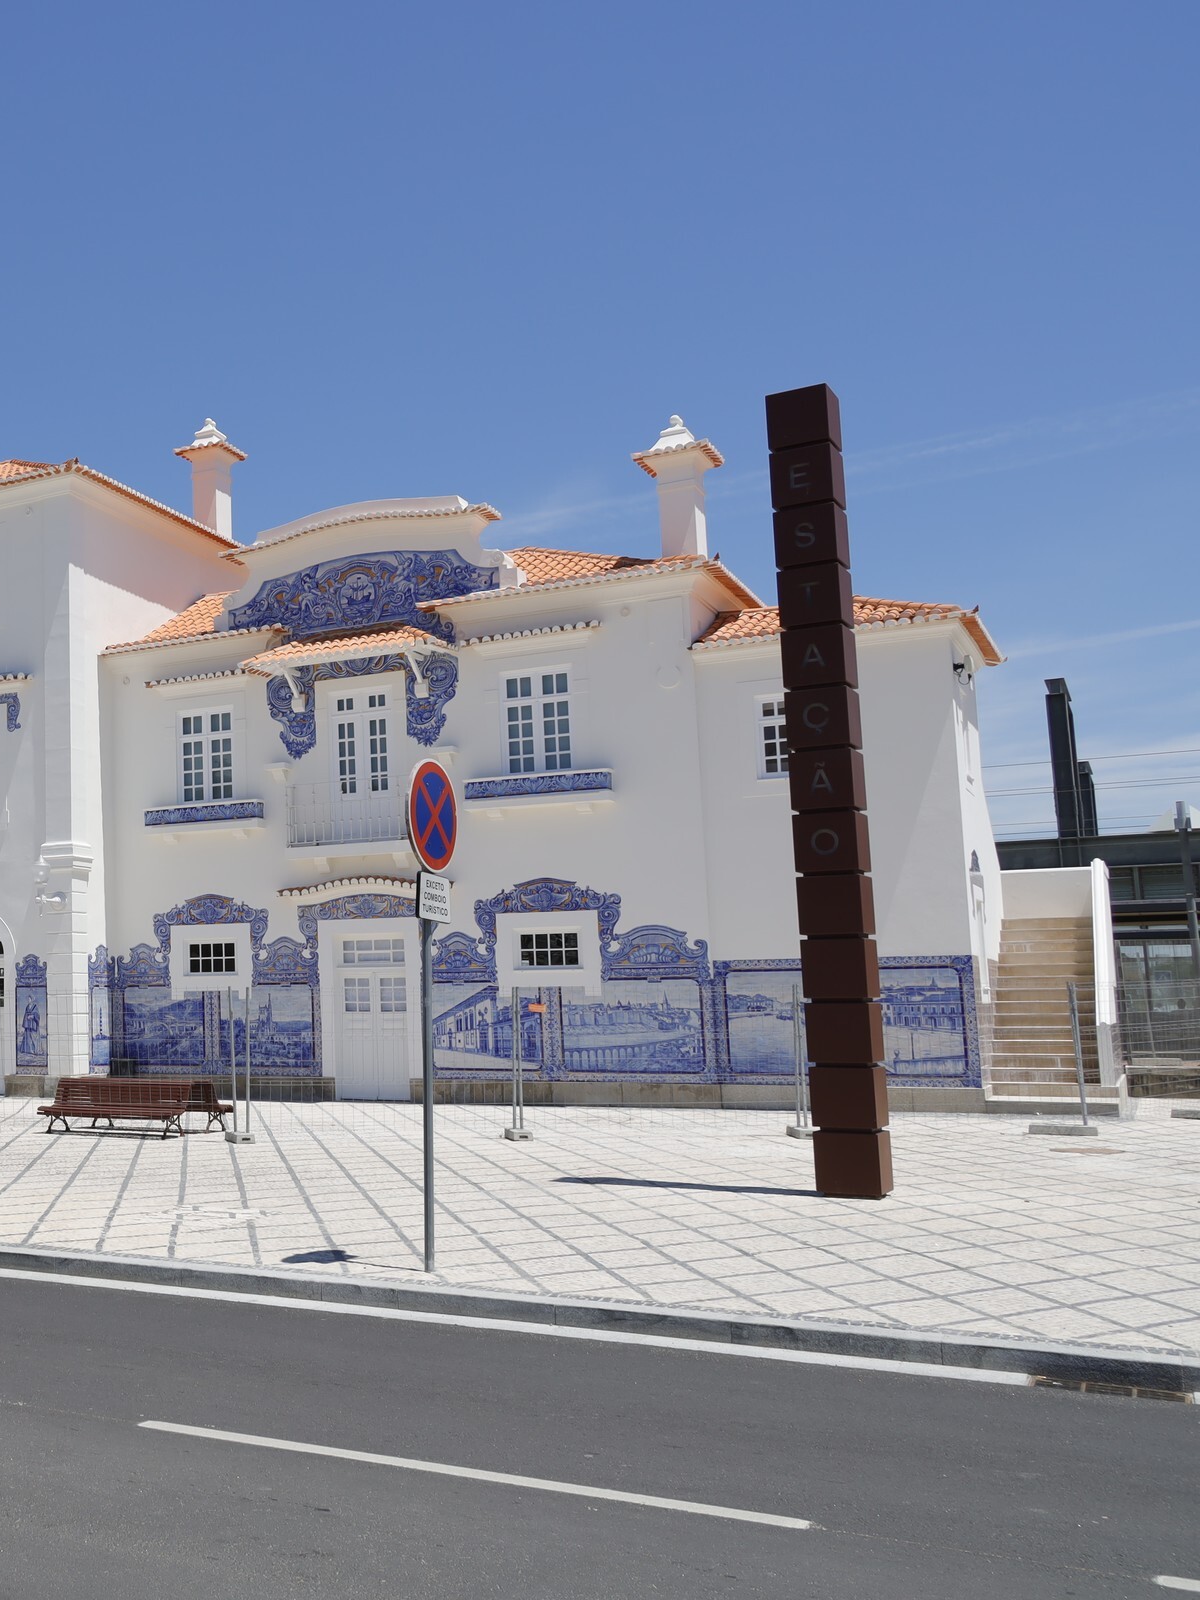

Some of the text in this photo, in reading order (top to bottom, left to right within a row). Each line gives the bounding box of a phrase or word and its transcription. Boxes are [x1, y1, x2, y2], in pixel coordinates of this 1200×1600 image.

[788, 462, 839, 855] ESTAÇÃO
[425, 880, 445, 891] EXCETO
[424, 892, 446, 903] COMBOIO
[423, 903, 448, 916] TURÍSTICO
